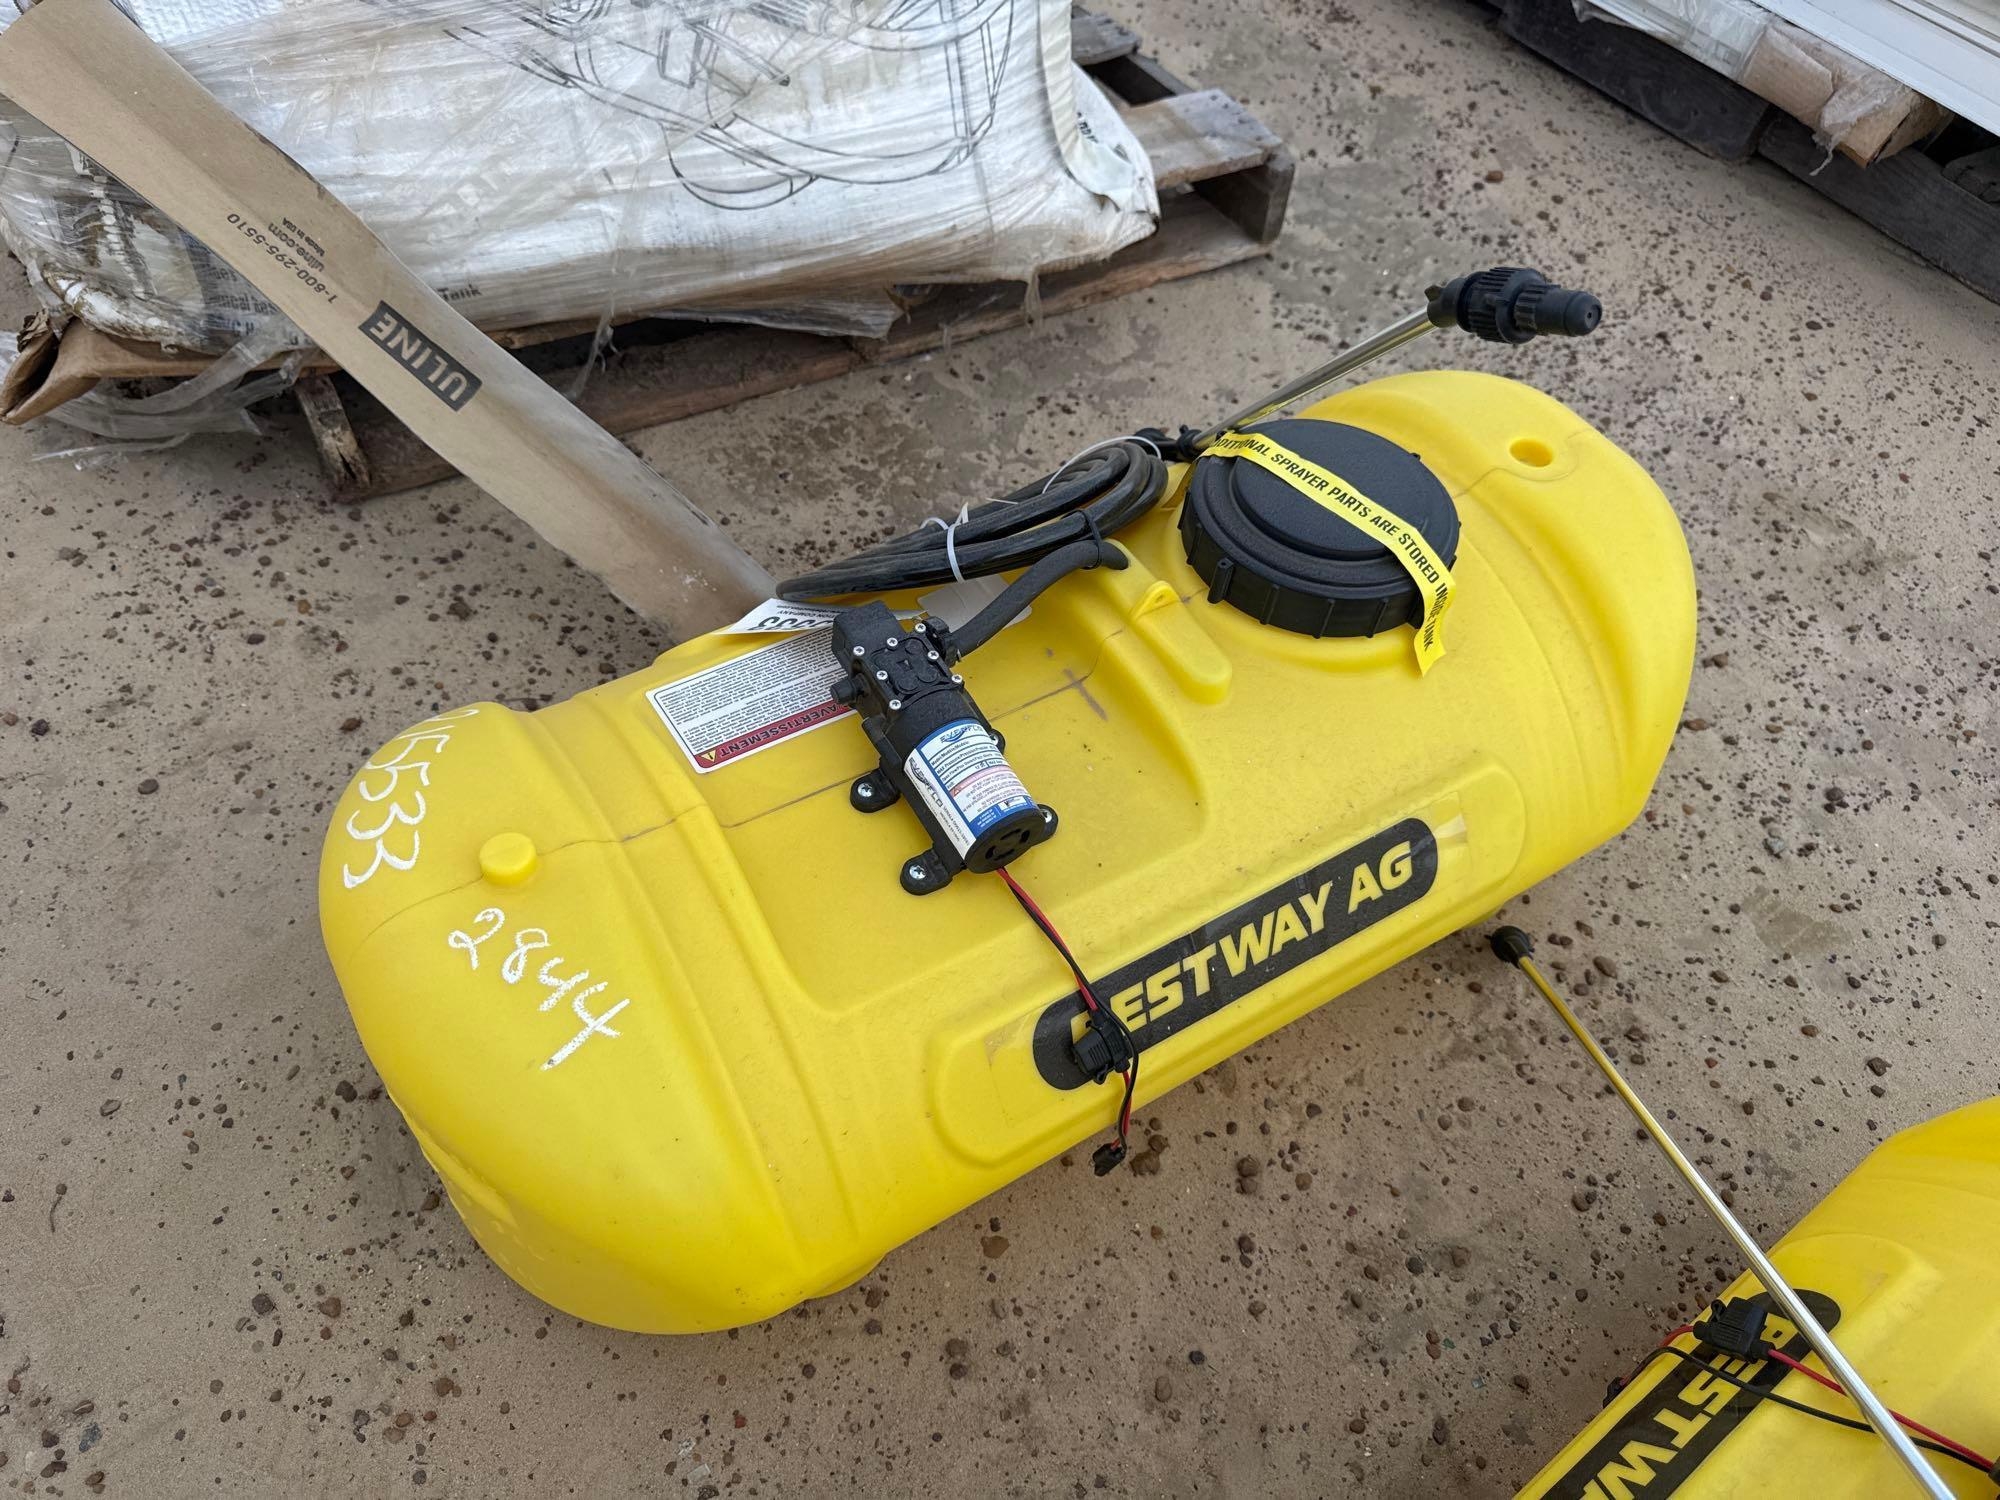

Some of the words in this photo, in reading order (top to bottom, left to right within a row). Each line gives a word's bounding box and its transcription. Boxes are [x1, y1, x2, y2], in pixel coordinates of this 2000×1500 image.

[226, 212, 338, 304] 1-800-295-5510
[267, 222, 325, 273] uline.com
[369, 311, 468, 402] ULINE
[1271, 453, 1330, 492] SPRAYER
[1327, 486, 1372, 518] PARTS
[1370, 510, 1400, 537] ARE
[1398, 533, 1440, 585] STORED
[1424, 619, 1437, 652] TANK
[720, 703, 838, 757] AVERTISSEMENT
[1348, 841, 1413, 915] AG
